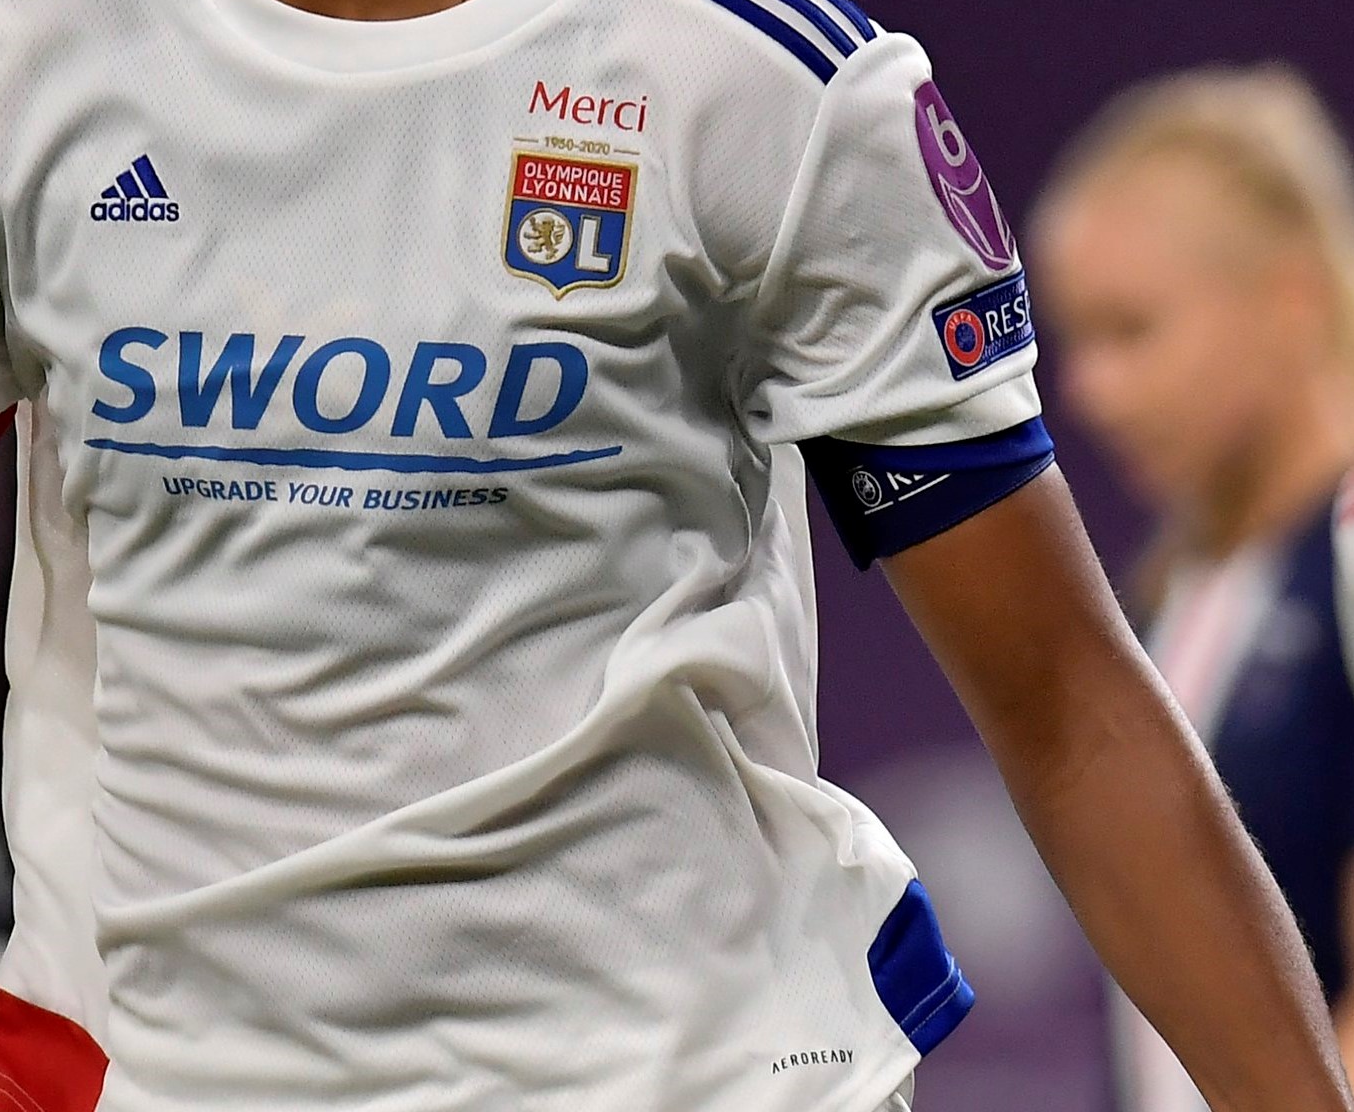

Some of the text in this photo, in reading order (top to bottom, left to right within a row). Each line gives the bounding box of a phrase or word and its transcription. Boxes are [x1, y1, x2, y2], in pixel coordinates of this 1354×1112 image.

[528, 80, 648, 133] Merci
[544, 136, 611, 156] 1950-2020
[524, 161, 624, 189] OLYMPIQUE
[522, 178, 622, 206] LYONNAIS
[90, 197, 180, 222] adidas
[92, 326, 589, 440] SWORD
[162, 476, 509, 511] UPGRADE YOUR BUSINESS
[772, 1049, 854, 1075] AEROREADY
